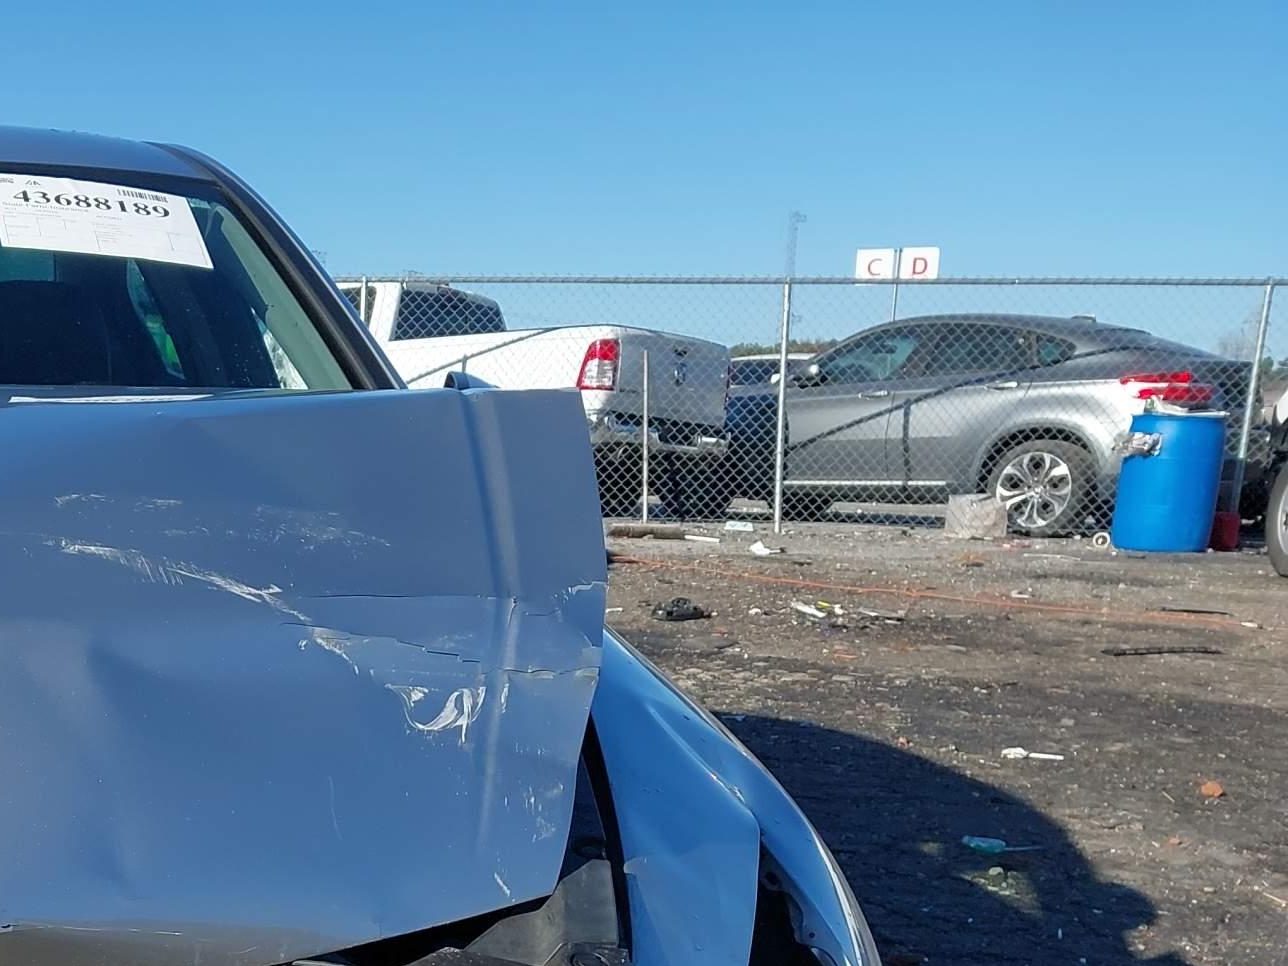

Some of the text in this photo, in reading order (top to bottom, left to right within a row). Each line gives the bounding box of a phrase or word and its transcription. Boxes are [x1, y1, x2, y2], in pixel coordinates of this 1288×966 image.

[13, 190, 170, 217] 43688189
[867, 258, 883, 276] C
[912, 257, 928, 275] D
